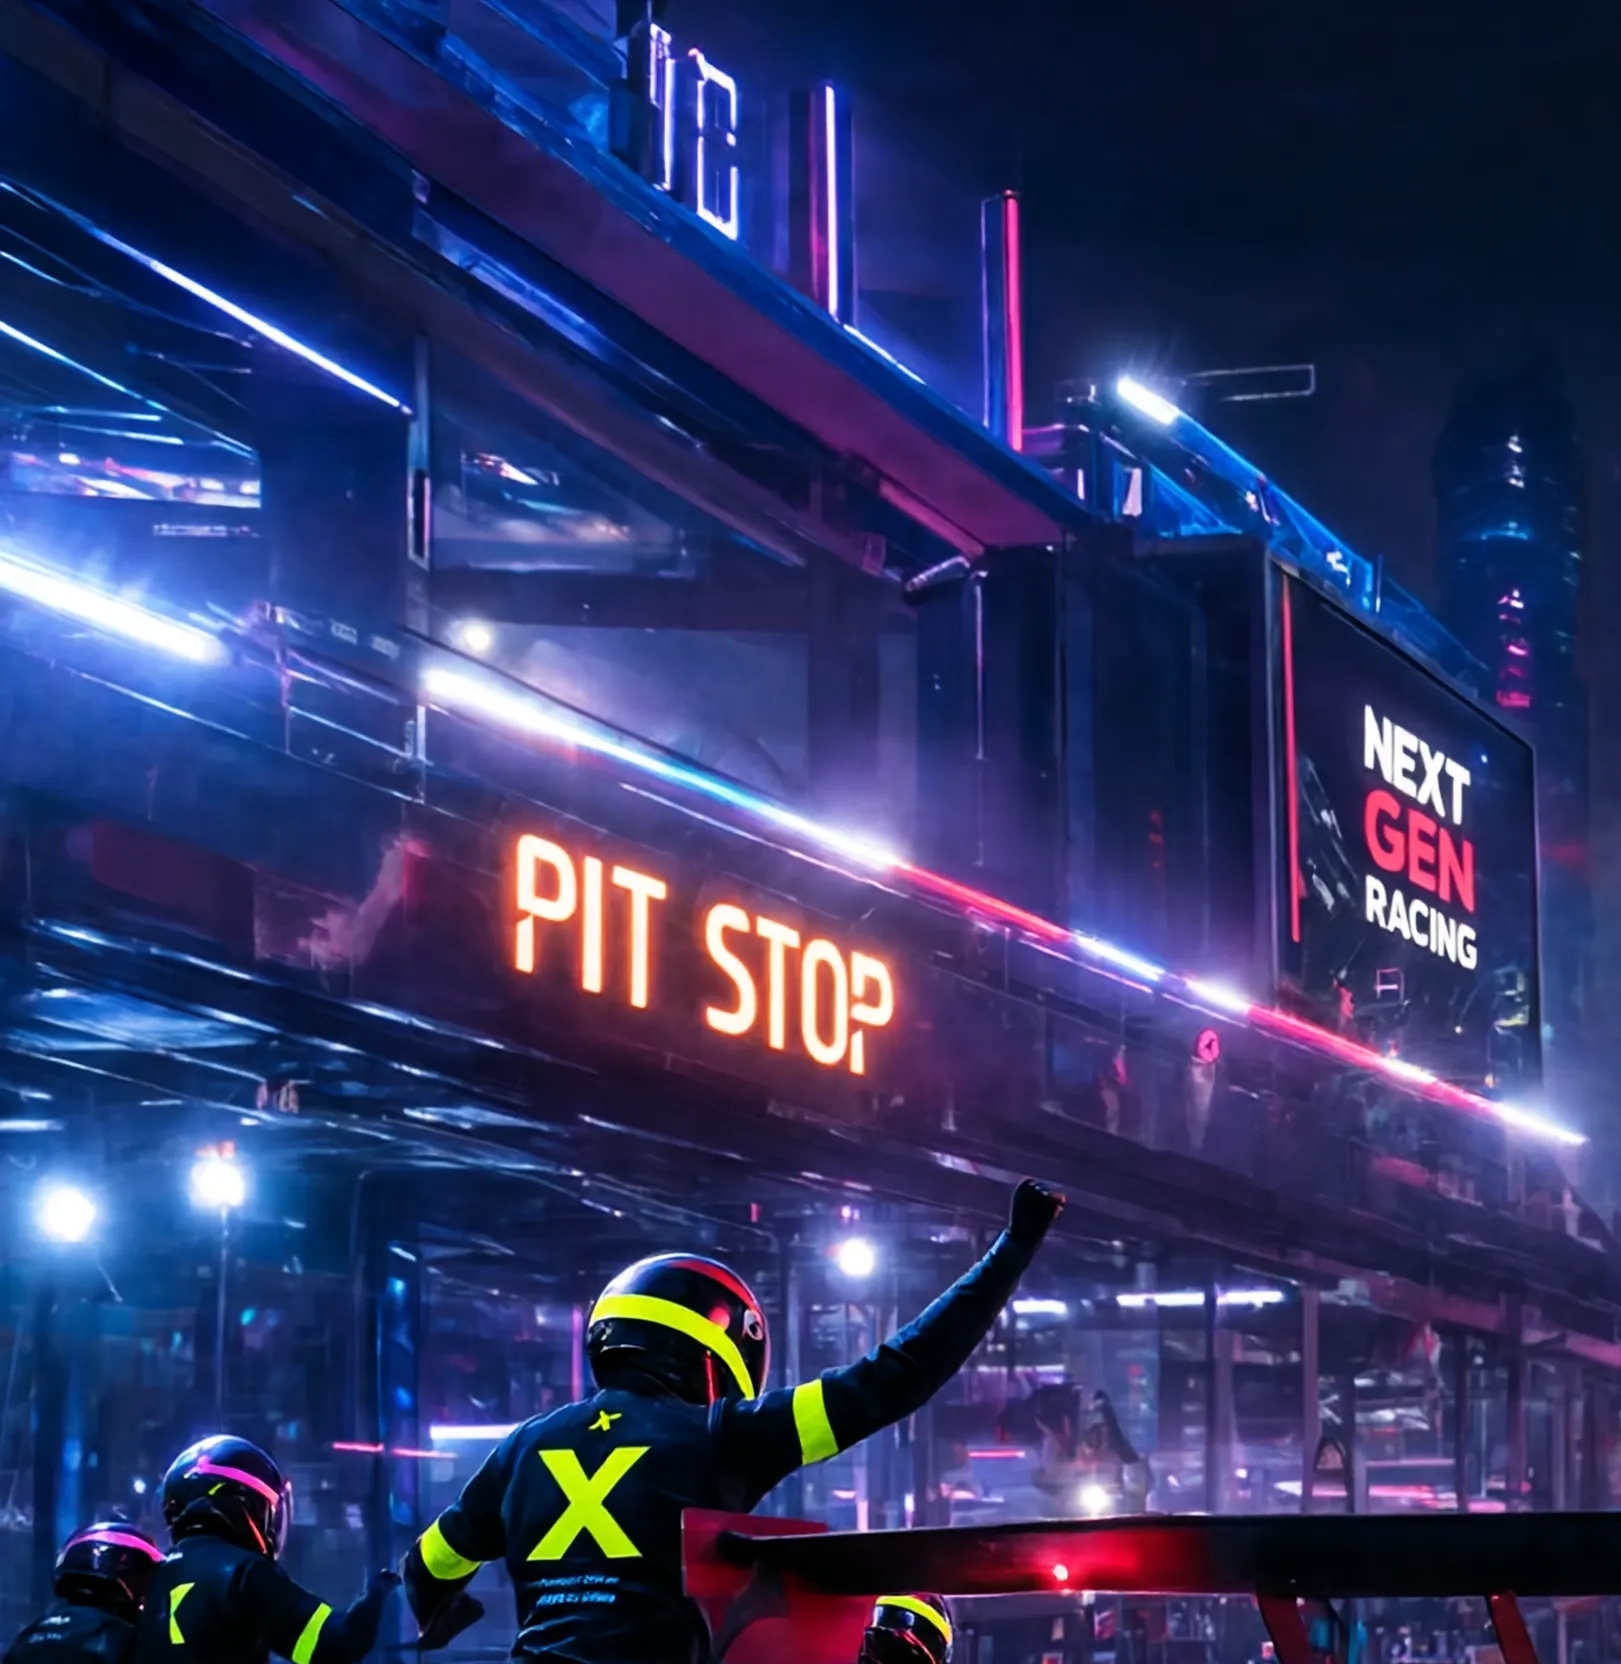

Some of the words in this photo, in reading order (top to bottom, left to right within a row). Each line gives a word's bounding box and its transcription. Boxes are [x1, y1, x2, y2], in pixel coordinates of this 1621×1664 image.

[1363, 704, 1471, 826] NEXT
[1364, 789, 1475, 913] GEN
[514, 833, 668, 1009] PIT
[704, 903, 894, 1075] STOP
[1365, 874, 1478, 970] RACING
